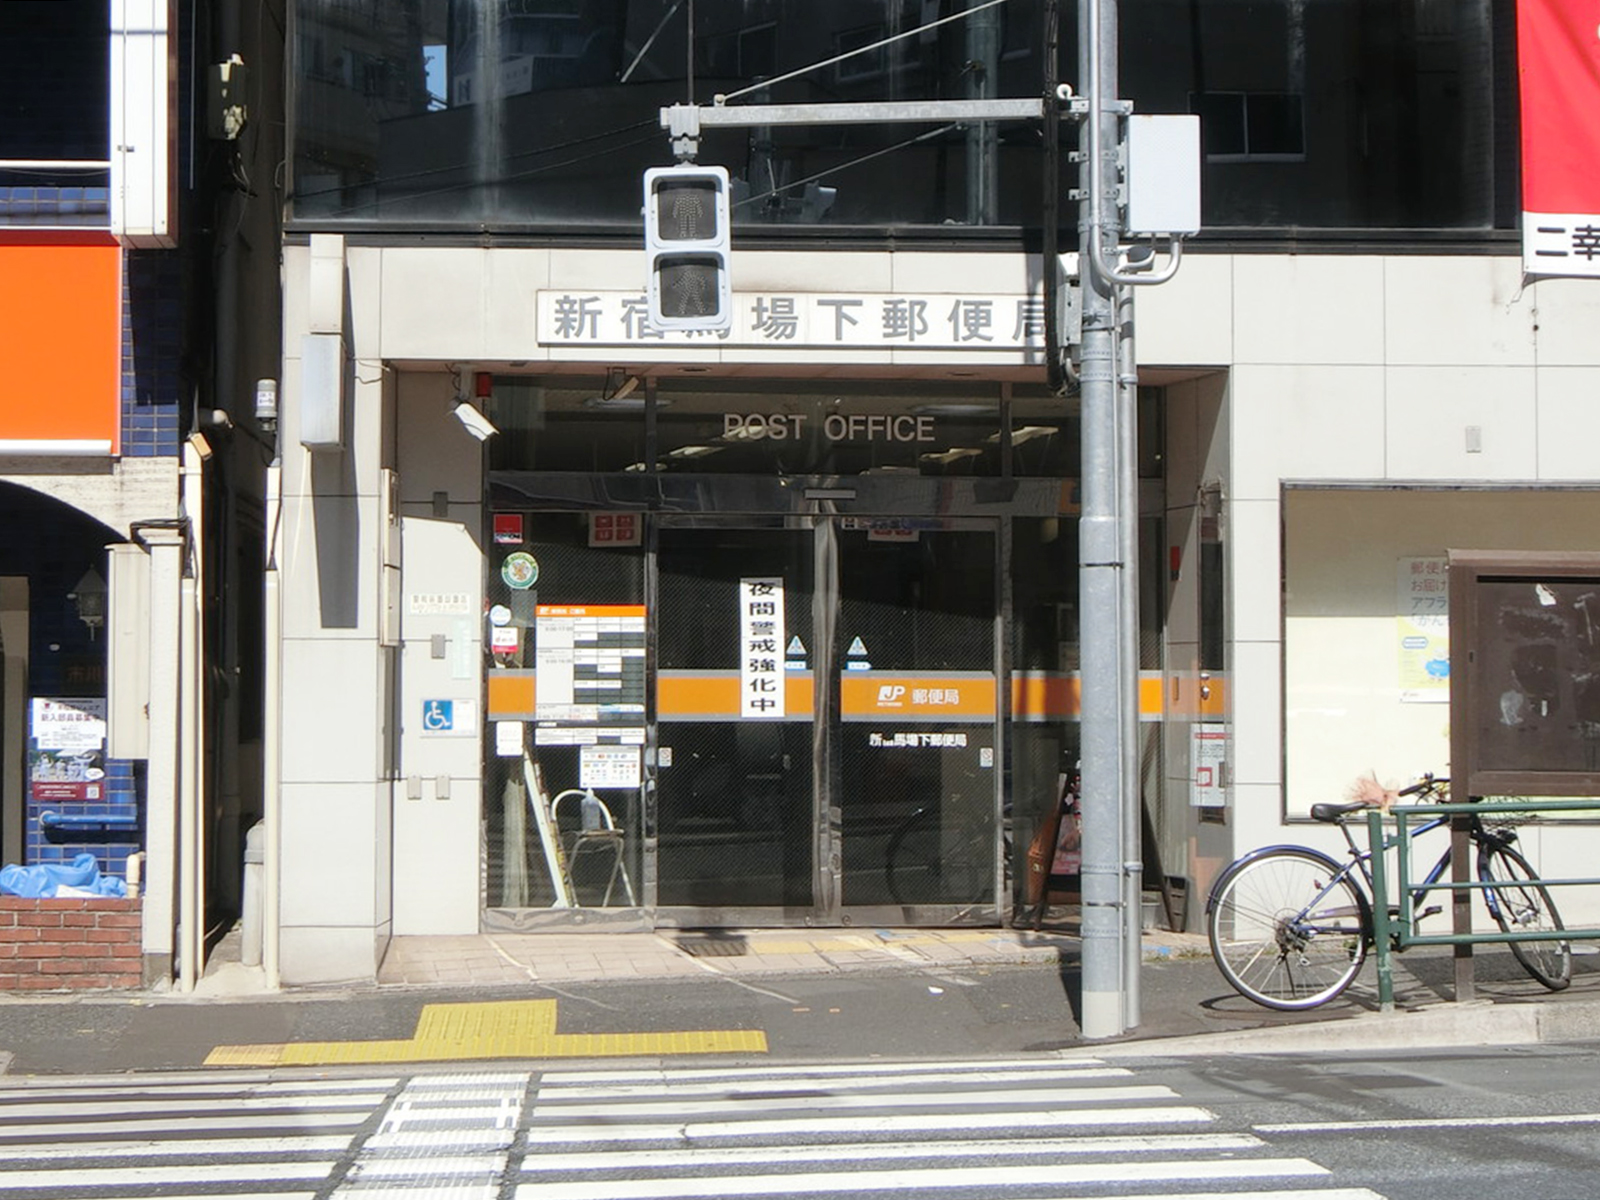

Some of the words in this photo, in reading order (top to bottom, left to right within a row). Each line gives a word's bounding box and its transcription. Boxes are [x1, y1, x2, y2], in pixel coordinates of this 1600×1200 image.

[1536, 225, 1600, 260] 二幸
[554, 294, 1047, 342] 新宿場下郵便局
[724, 412, 807, 441] POST
[824, 414, 936, 441] OFFICE
[748, 581, 777, 713] 夜間警戒強化中
[912, 689, 959, 705] 郵便局
